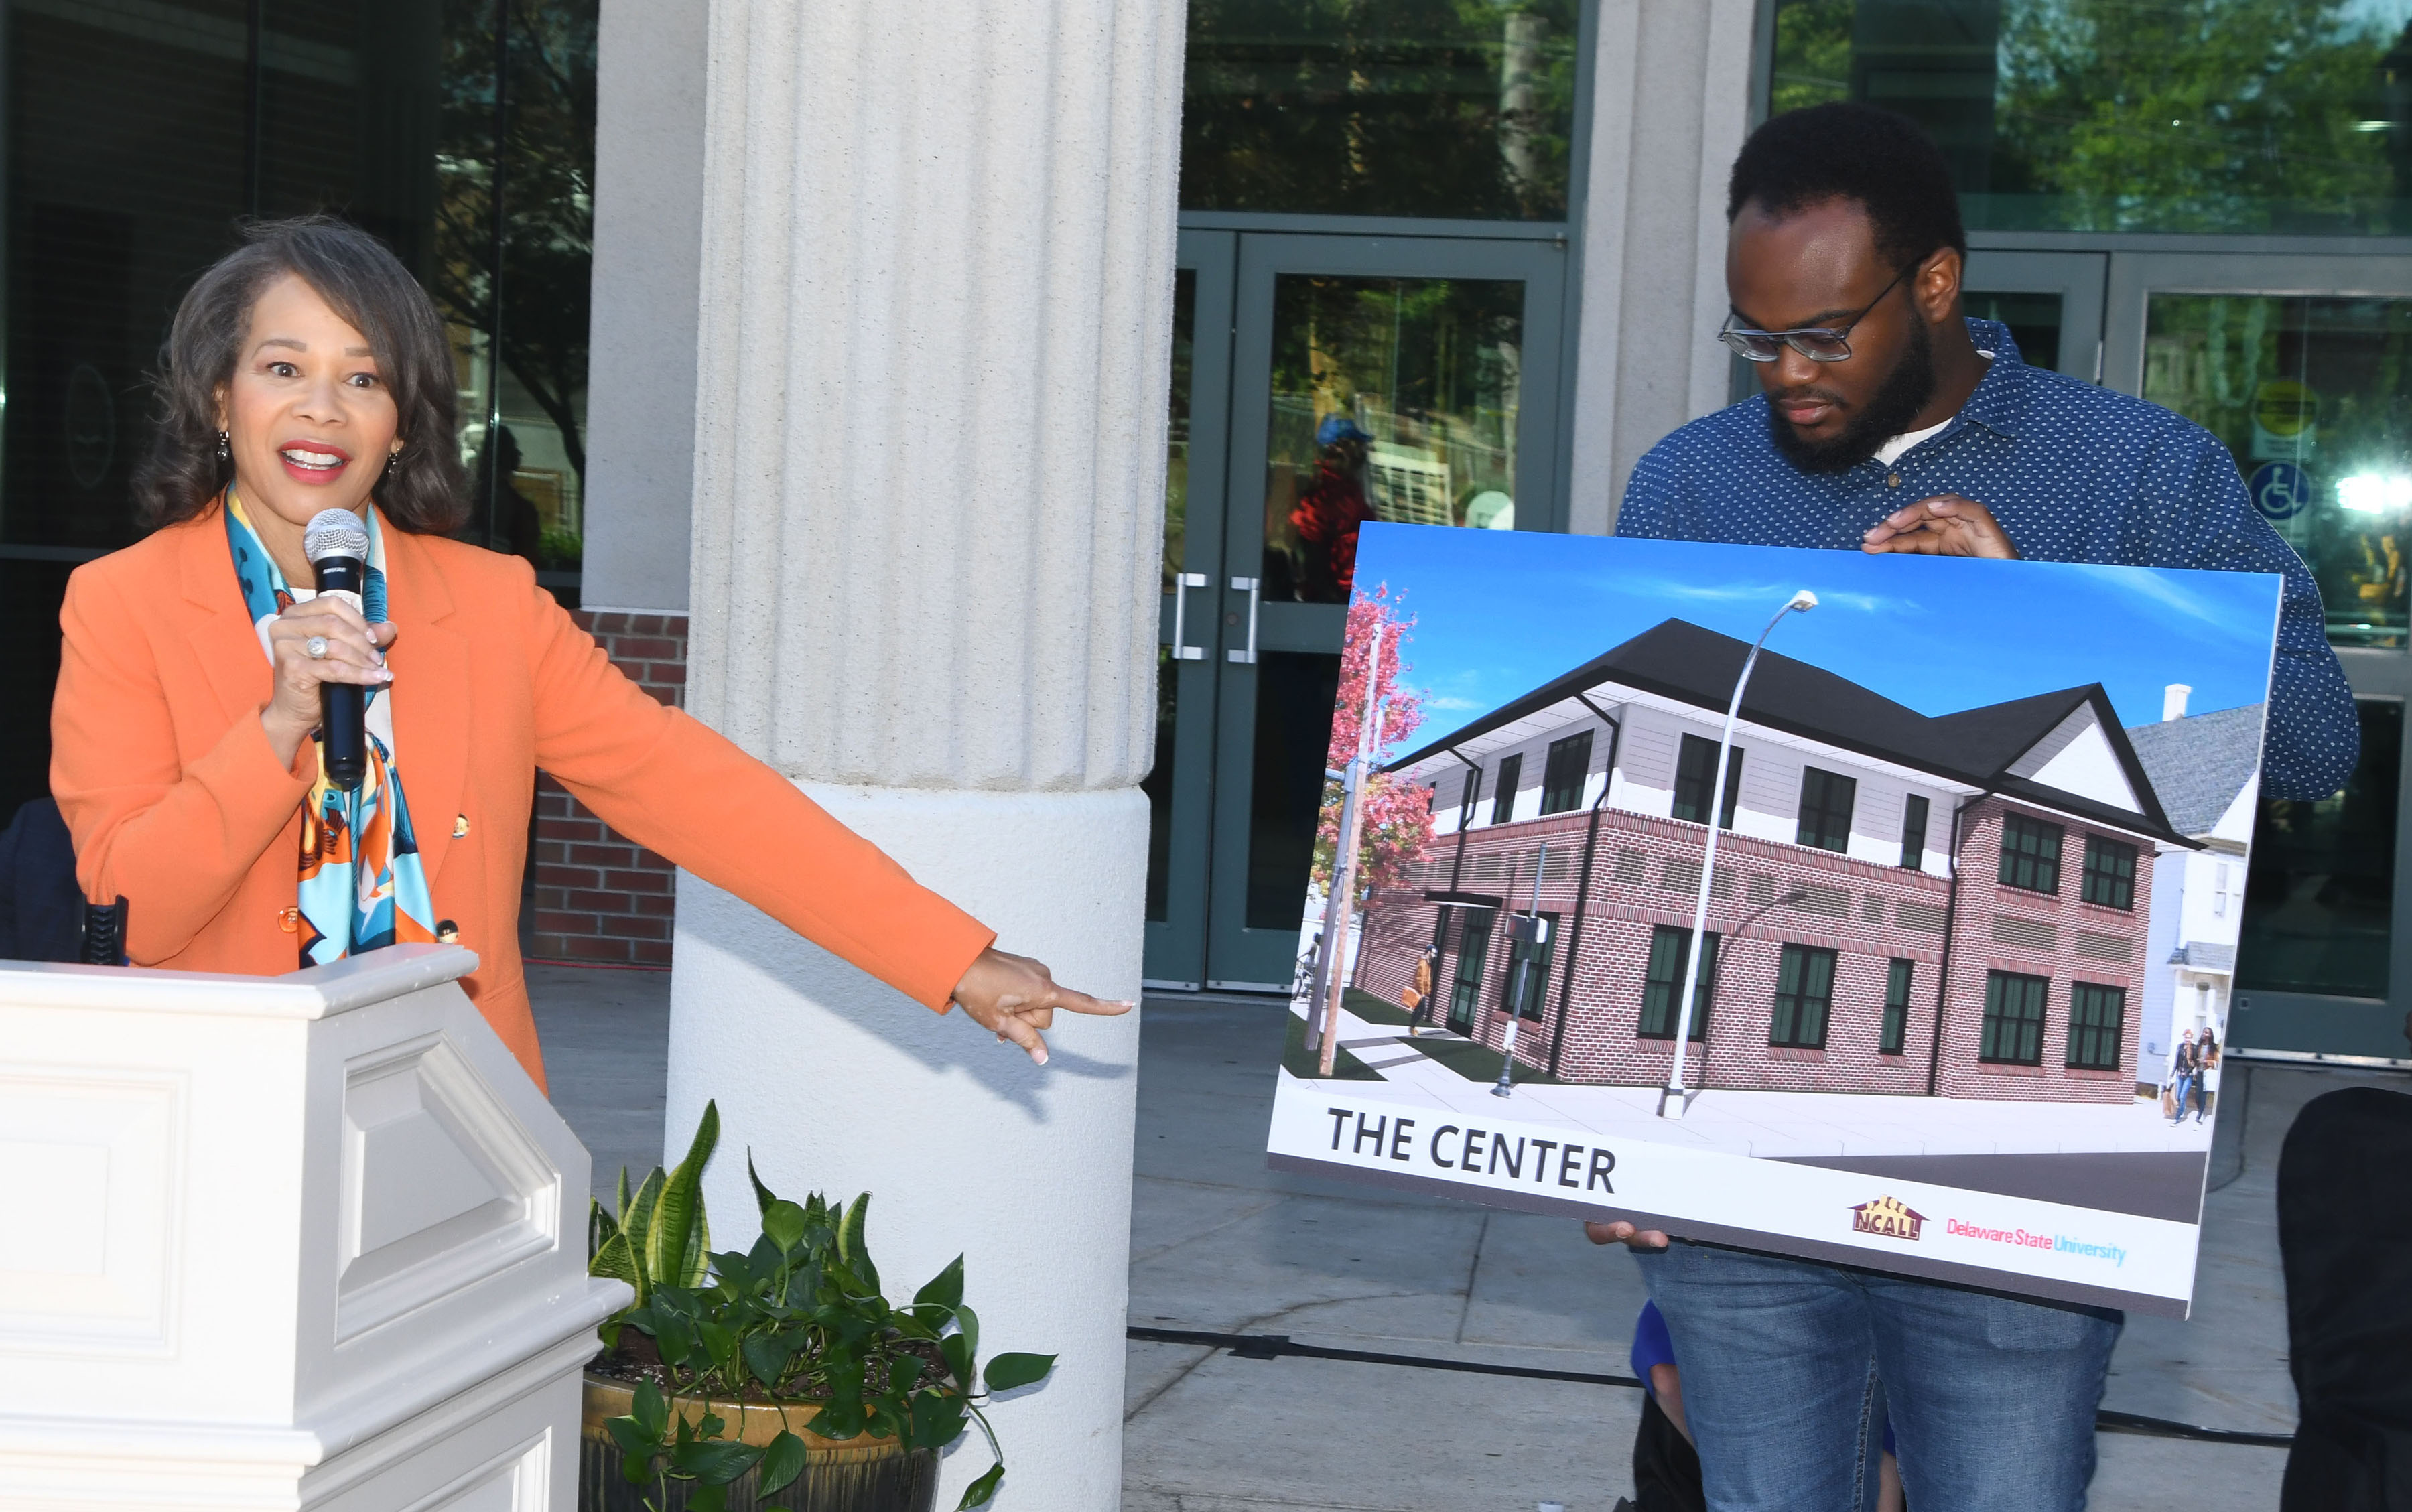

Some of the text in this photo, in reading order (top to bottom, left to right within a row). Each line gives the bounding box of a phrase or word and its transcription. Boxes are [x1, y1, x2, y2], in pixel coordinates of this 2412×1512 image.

[1327, 1107, 1615, 1194] THE CENTER
[1855, 1211, 1919, 1238] NCALL
[1947, 1218, 2127, 1268] Delaware State University
